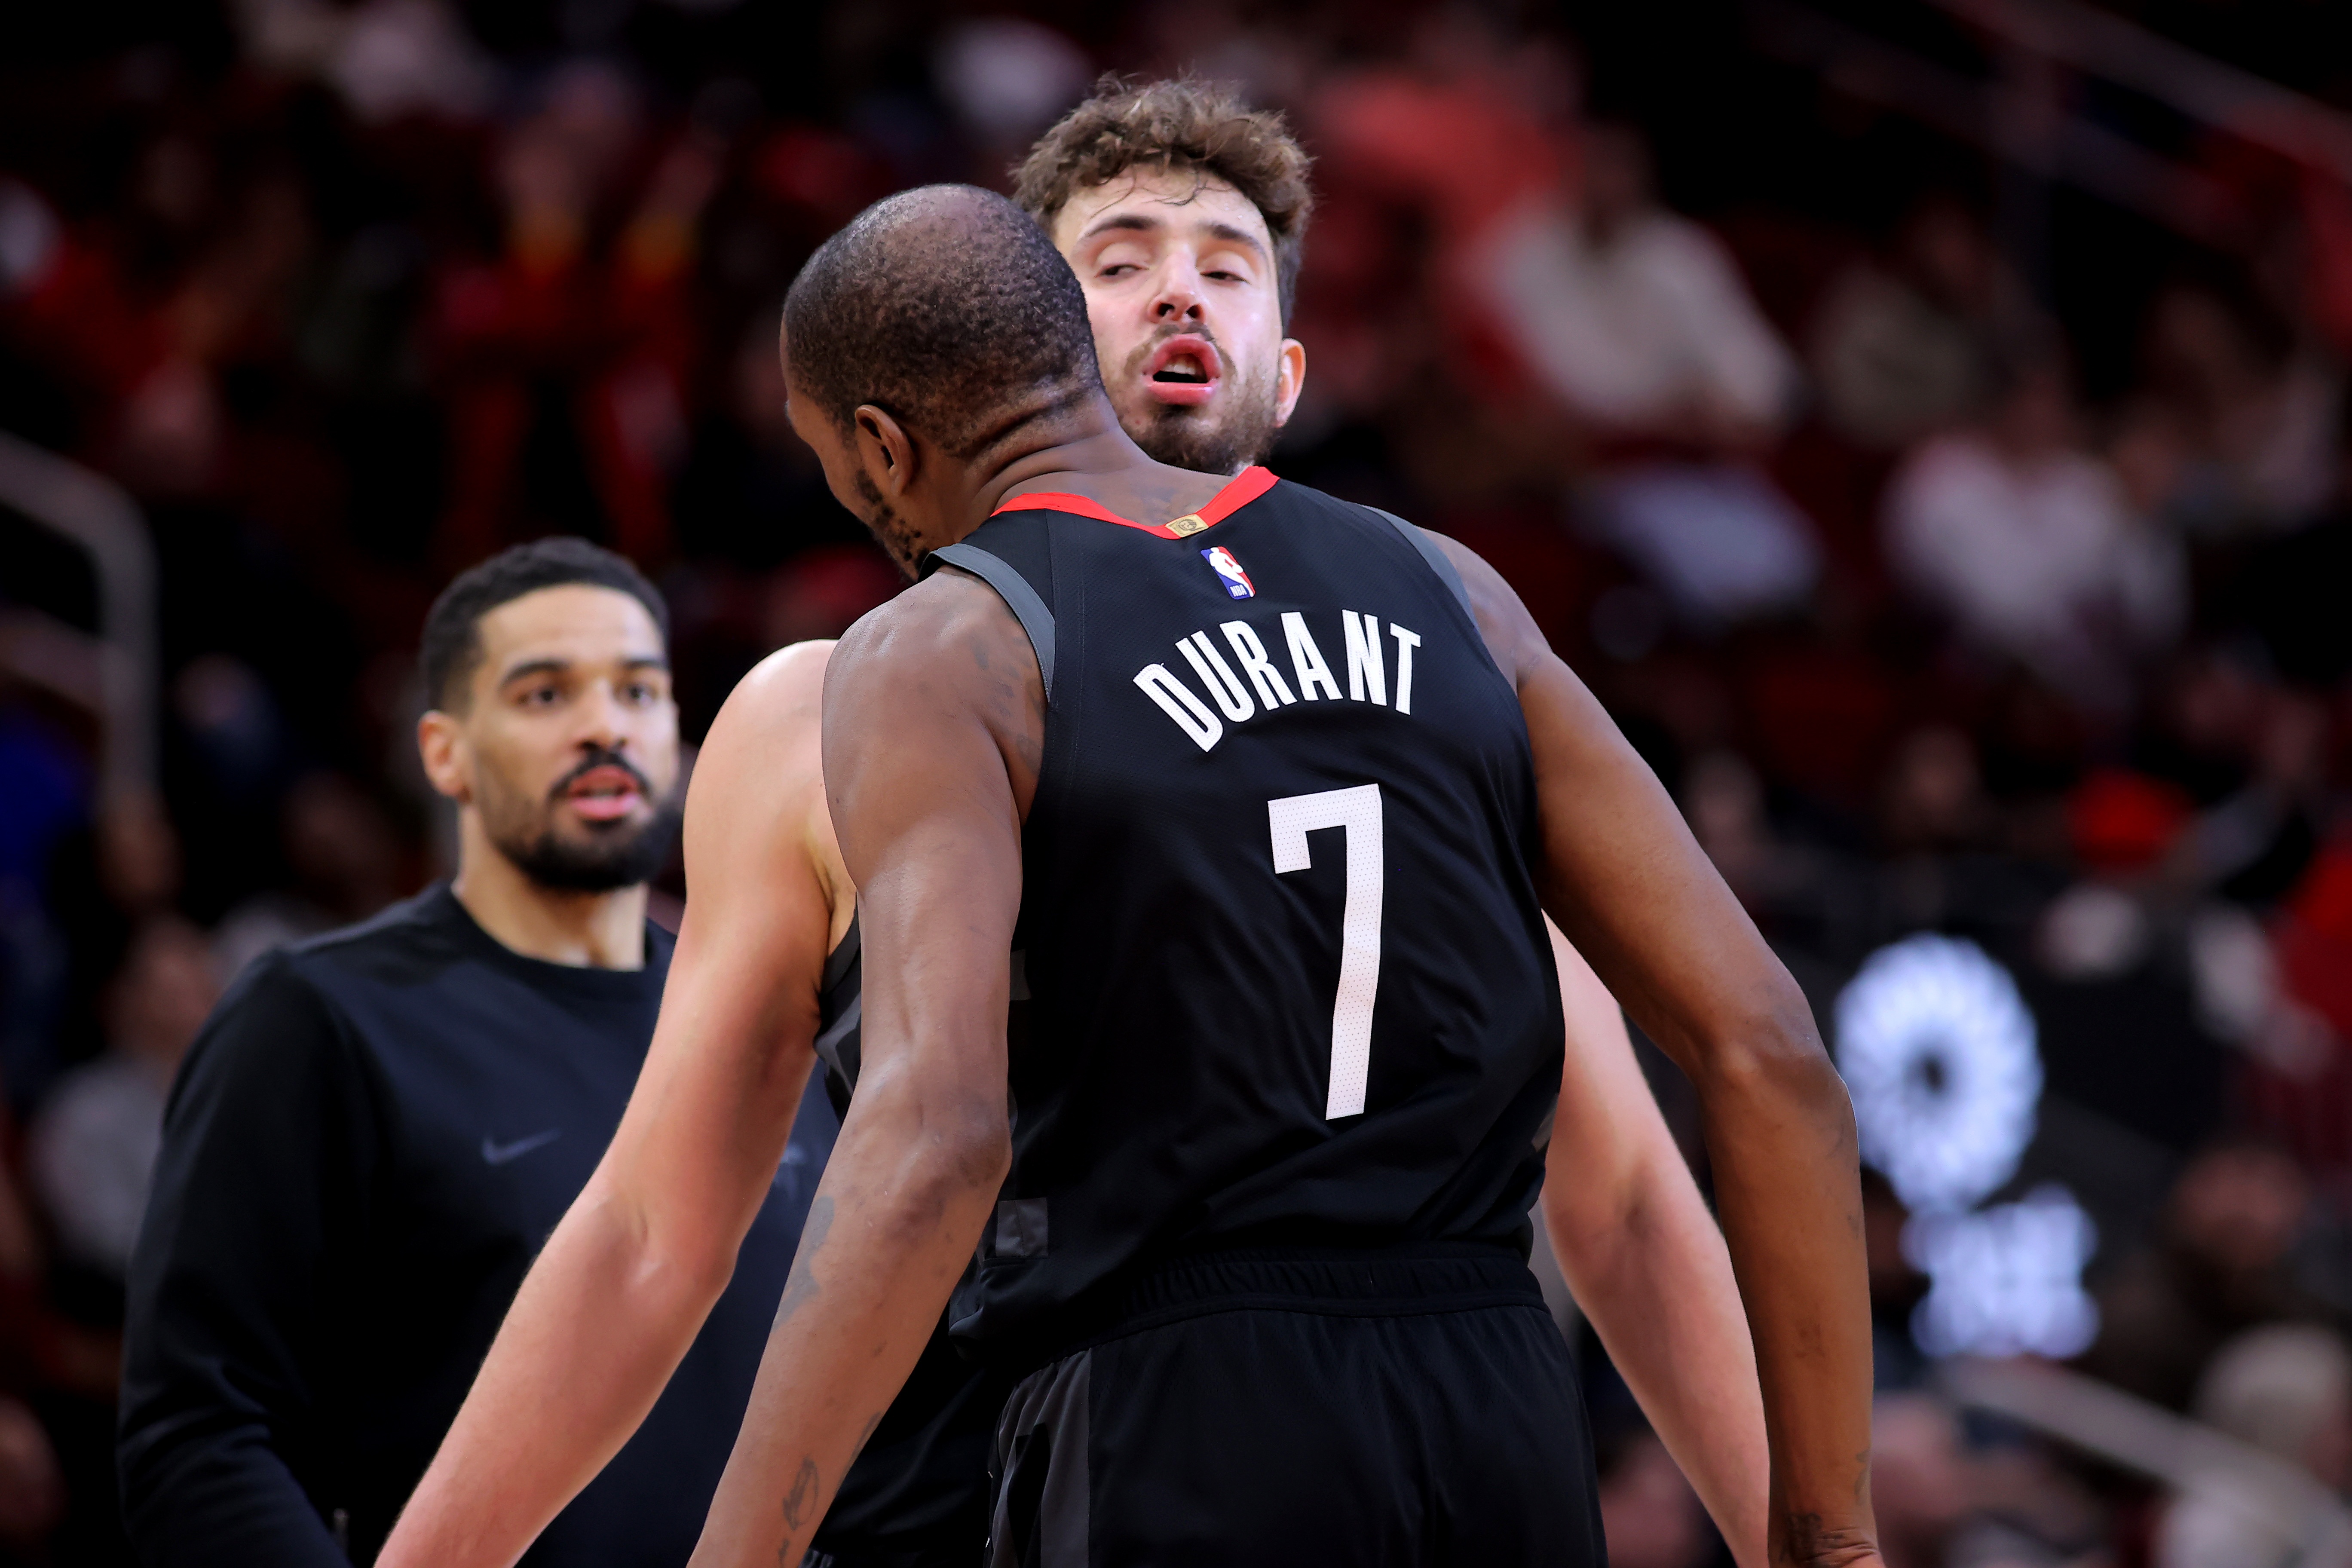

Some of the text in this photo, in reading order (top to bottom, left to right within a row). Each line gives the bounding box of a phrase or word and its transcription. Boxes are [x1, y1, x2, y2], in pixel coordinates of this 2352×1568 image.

[1230, 584, 1247, 597] NBA
[1132, 609, 1421, 753] DURANT
[1268, 783, 1384, 1120] 7
